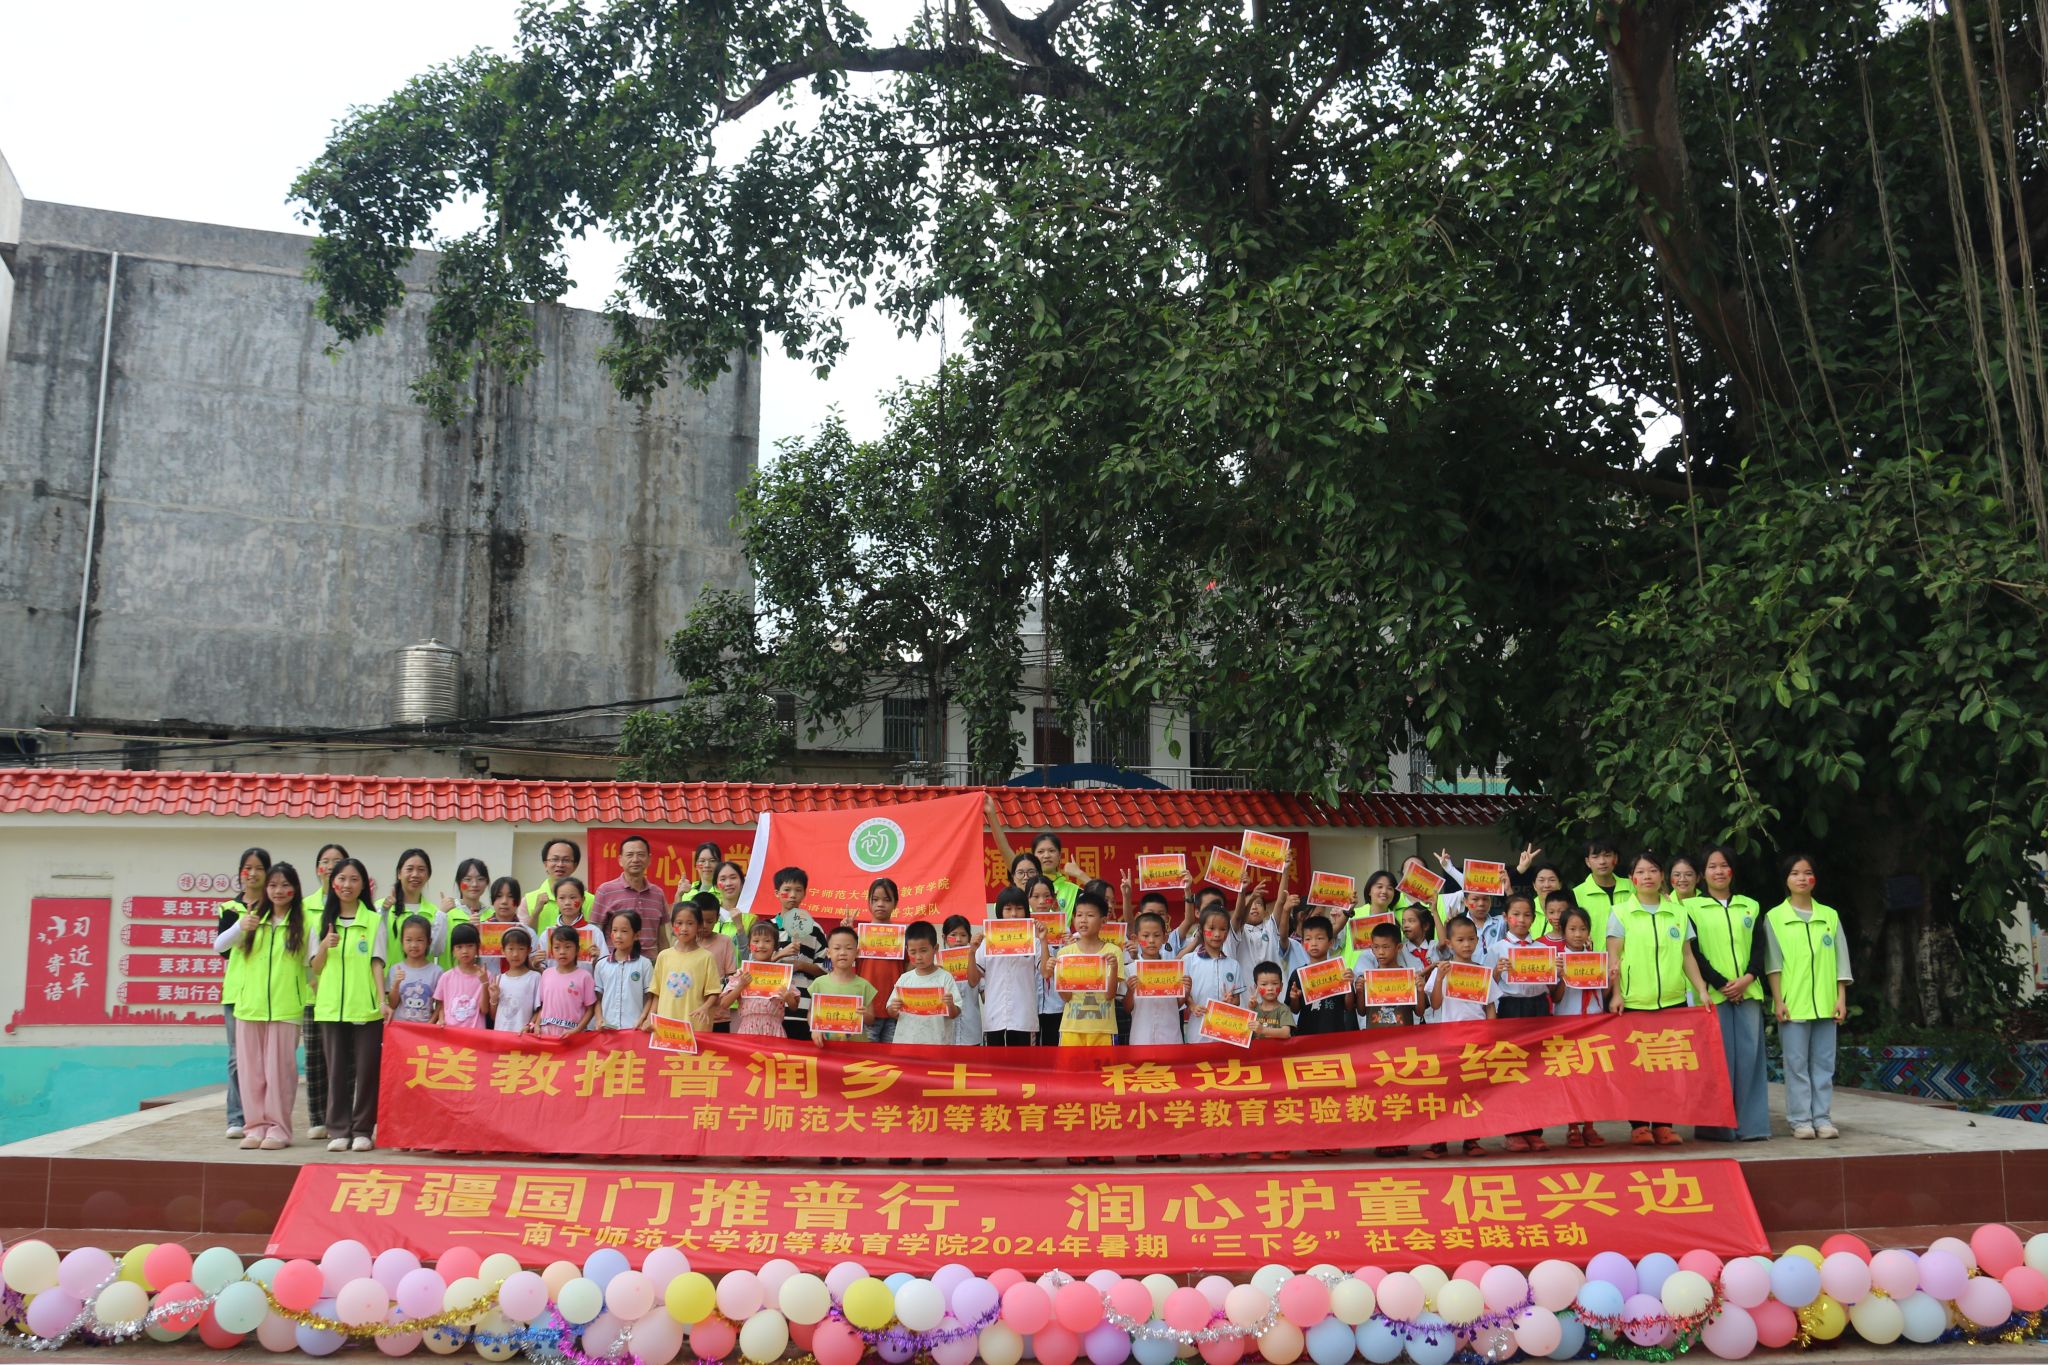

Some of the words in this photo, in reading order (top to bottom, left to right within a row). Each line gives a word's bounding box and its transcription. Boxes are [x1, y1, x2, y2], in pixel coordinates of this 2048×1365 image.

[44, 953, 66, 1001] 寄语
[67, 916, 93, 998] 习近平
[158, 957, 227, 973] 要求真学
[405, 1029, 1700, 1099] 送教推普润乡土，稳边固边绘新篇
[330, 1168, 1714, 1233] 南疆国门推普行，润心护童促兴边
